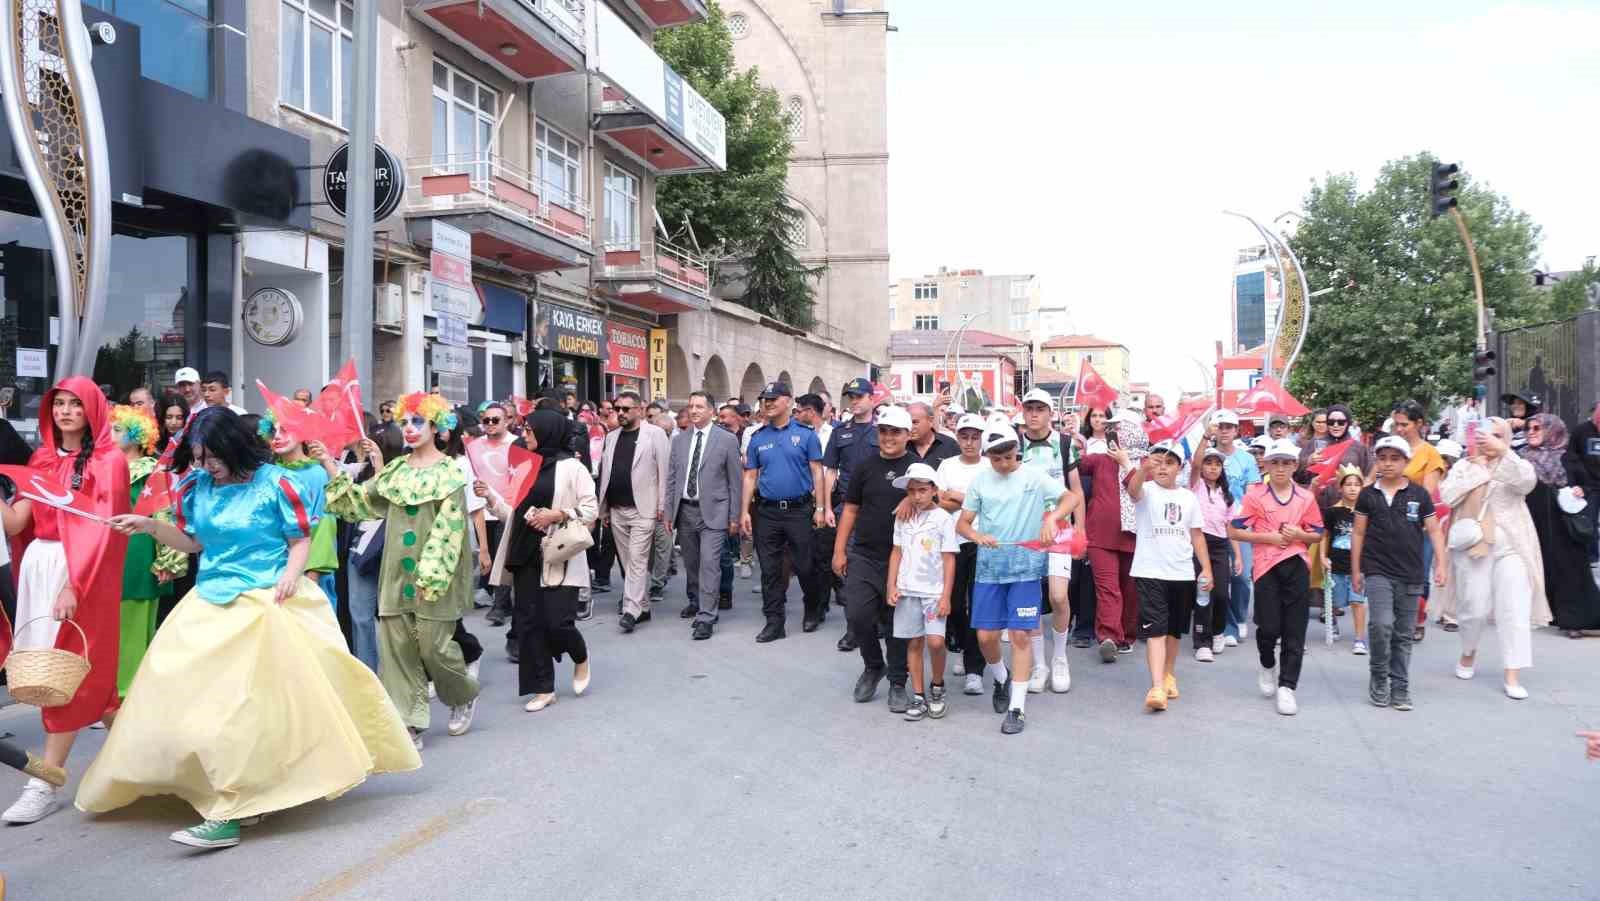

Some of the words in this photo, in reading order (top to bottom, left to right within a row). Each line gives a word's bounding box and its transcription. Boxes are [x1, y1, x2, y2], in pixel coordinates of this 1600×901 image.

[328, 167, 389, 184] TAIR
[552, 309, 575, 330] KAYA
[576, 315, 603, 336] ERKEK
[558, 334, 599, 355] KUAFÖRÜ
[611, 329, 647, 350] TOBACCO
[620, 354, 640, 371] SHOP
